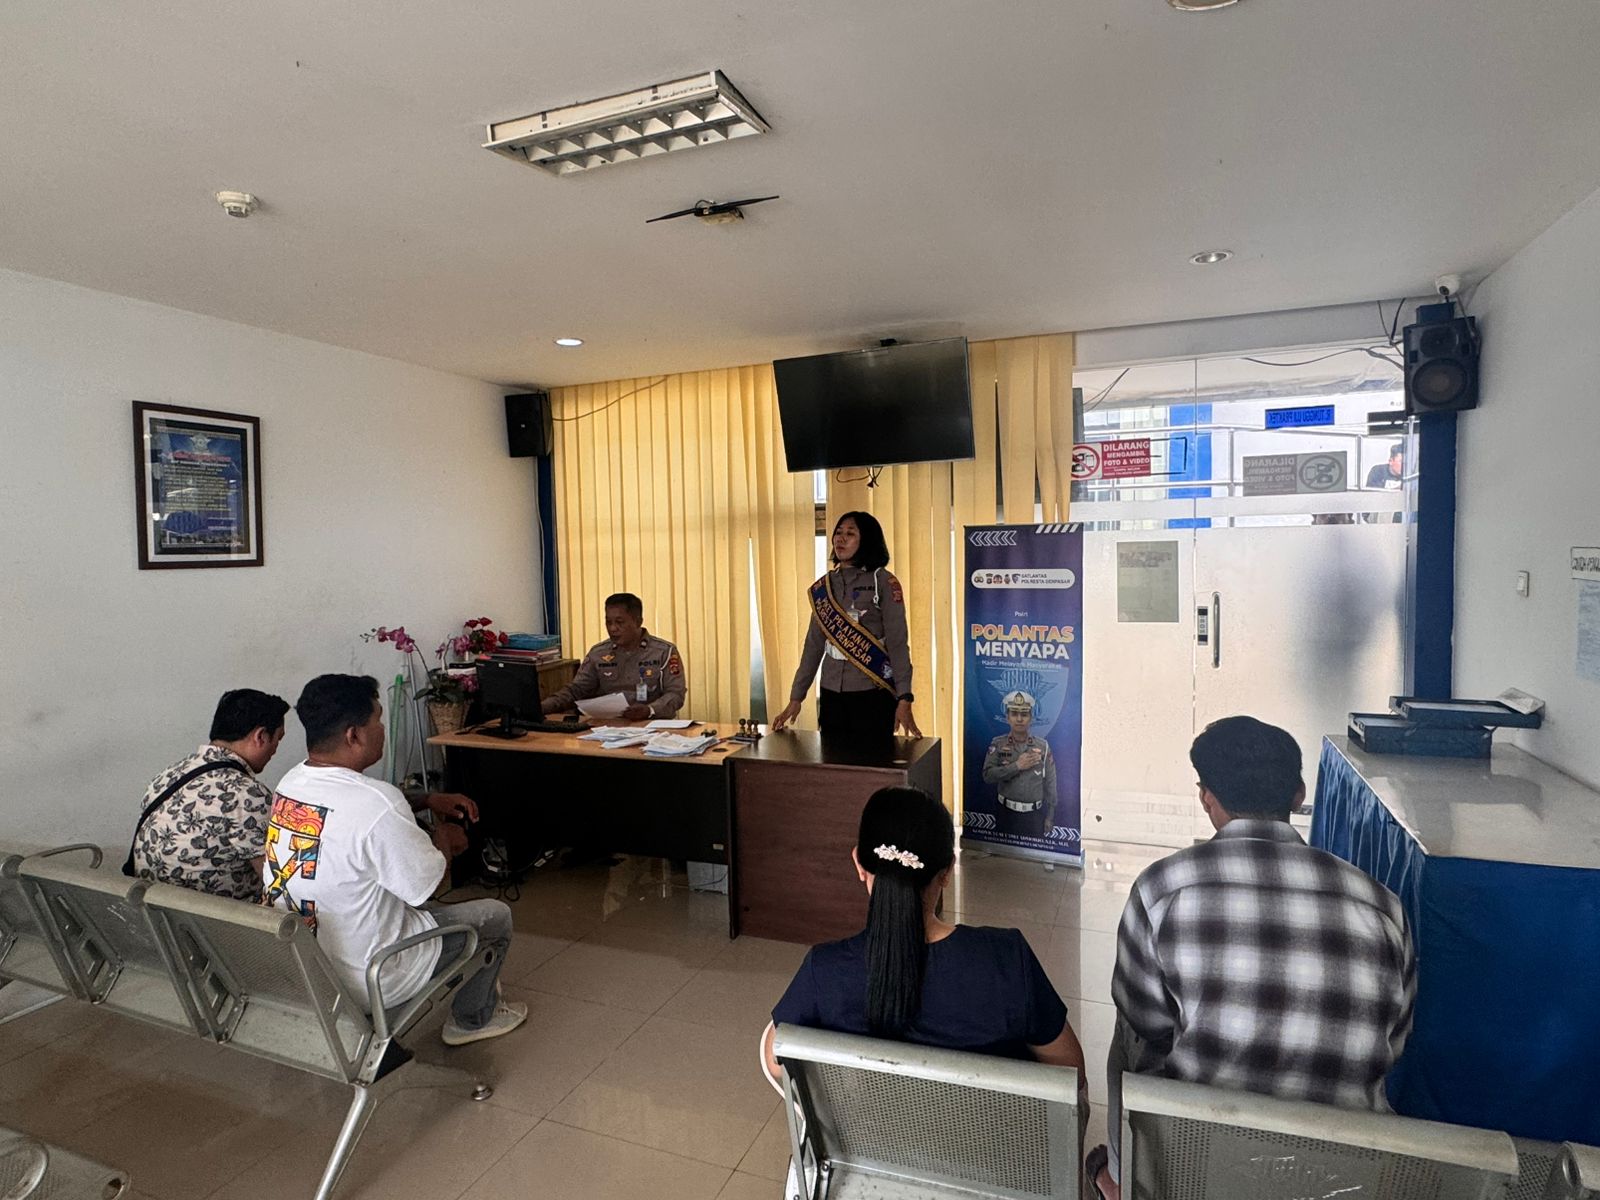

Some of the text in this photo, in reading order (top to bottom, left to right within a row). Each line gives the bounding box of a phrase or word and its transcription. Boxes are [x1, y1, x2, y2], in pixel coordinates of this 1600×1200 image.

[1103, 441, 1149, 452] DILARANG
[1106, 450, 1146, 458] MENGAMBIL
[833, 614, 872, 652] PELAYANAN
[970, 624, 1074, 644] POLANTAS
[836, 630, 872, 665] DENPASAR
[976, 641, 1070, 660] MENYAPA
